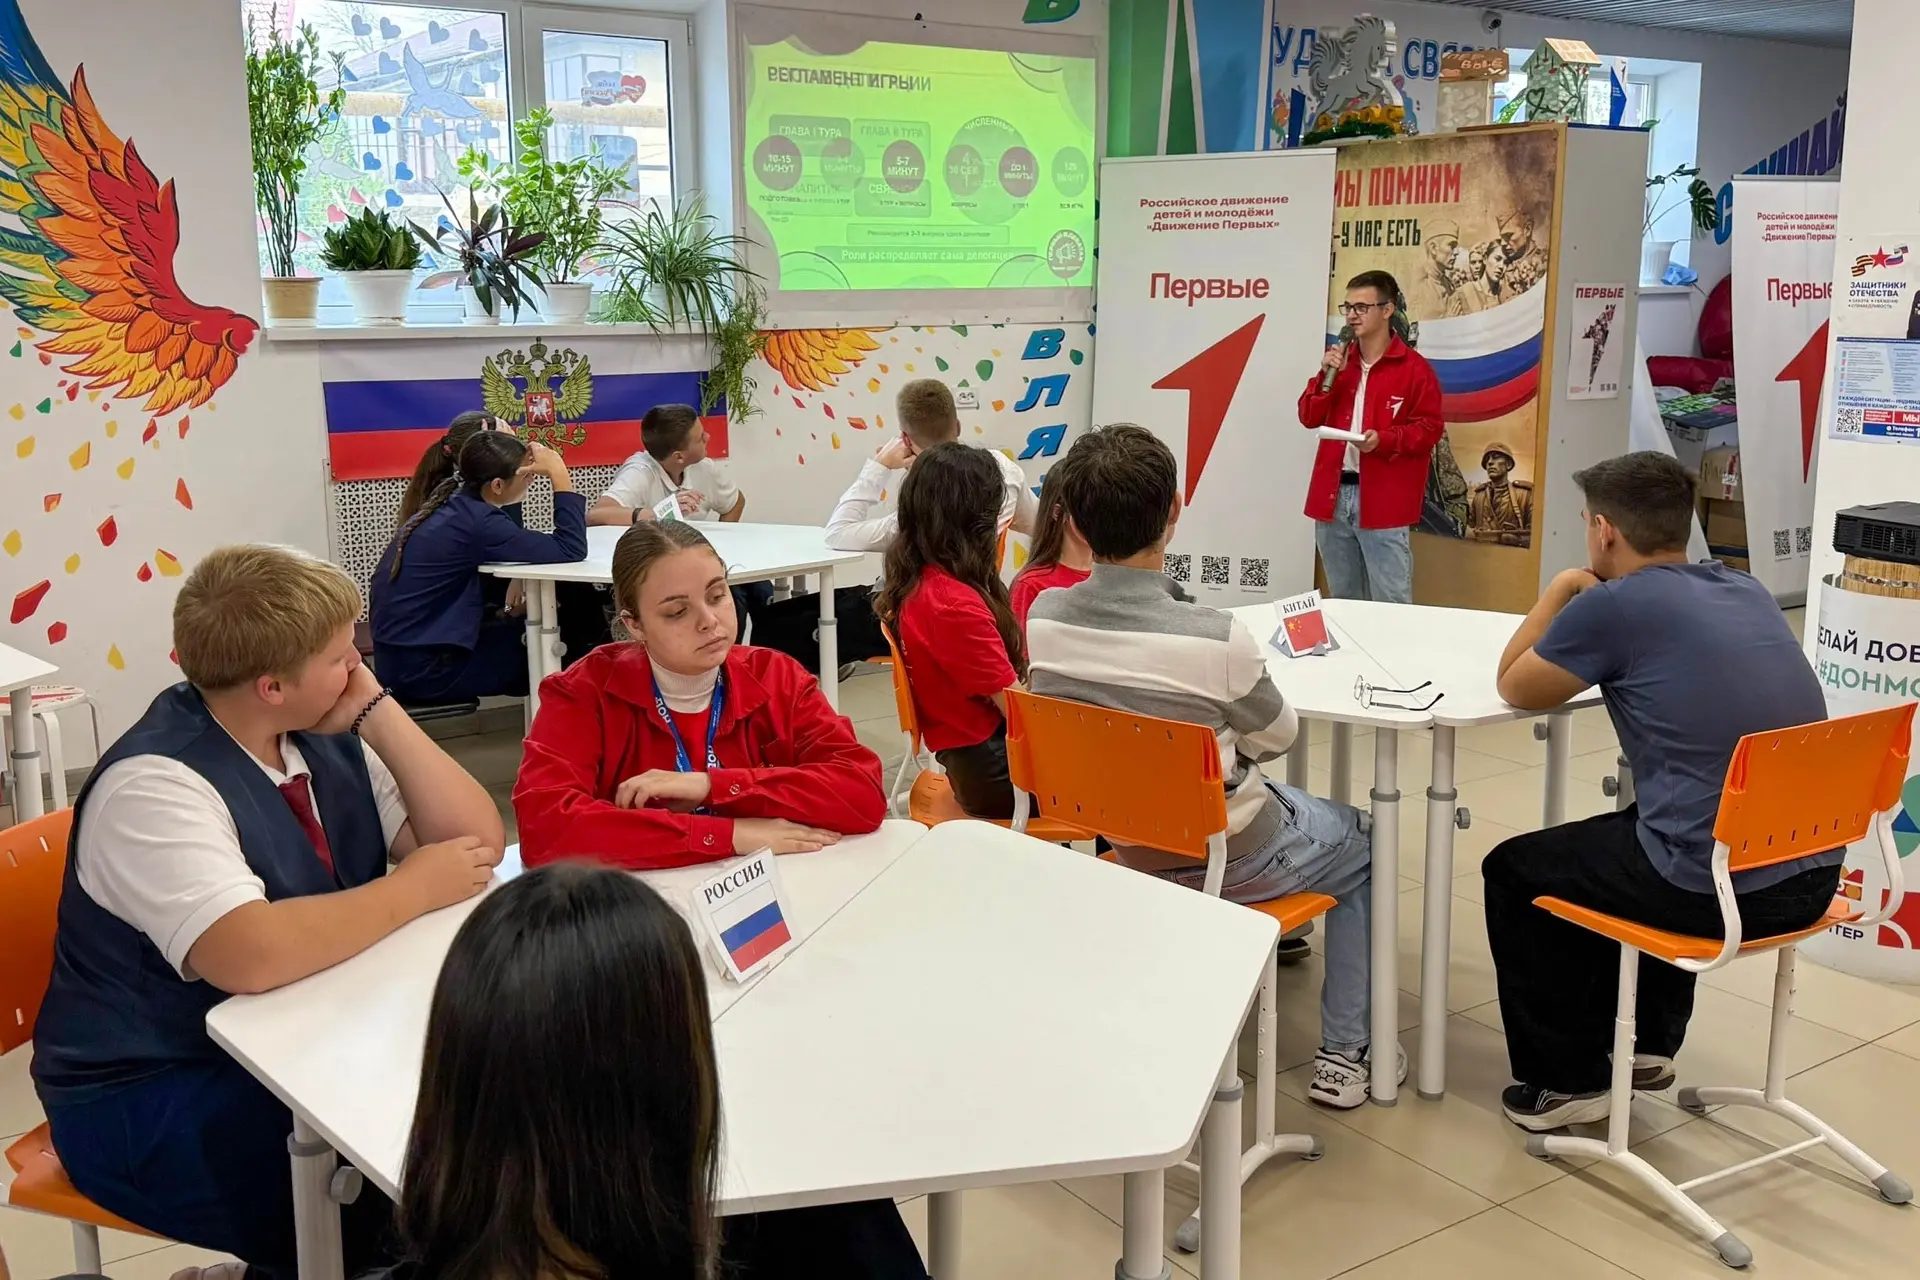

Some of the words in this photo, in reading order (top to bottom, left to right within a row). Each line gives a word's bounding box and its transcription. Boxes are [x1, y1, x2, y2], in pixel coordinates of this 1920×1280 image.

[1368, 162, 1462, 206] ПОМНИМ
[1140, 197, 1218, 208] Российское
[1220, 195, 1289, 206] движение
[1153, 209, 1191, 220] детей
[1193, 210, 1202, 218] и
[1204, 207, 1274, 219] молодёжи
[1757, 211, 1804, 221] Российское
[1147, 221, 1220, 232] «Движение
[1222, 220, 1280, 231] Первых»
[1765, 221, 1789, 231] детей
[1797, 222, 1835, 231] молодёжи
[1355, 220, 1382, 247] НАС
[1387, 219, 1421, 246] ЕСТЬ
[1762, 233, 1806, 242] «Движение
[1150, 272, 1270, 307] Первые
[1850, 281, 1907, 289] ЗАЩИТНИКИ
[1575, 288, 1624, 299] ПЕРВЫЕ
[1849, 289, 1899, 297] ОТЕЧЕСТВА
[1283, 596, 1315, 614] КИТАЙ
[1818, 625, 1858, 655] ЕЛАЙ
[704, 860, 765, 904] РОССИЯ
